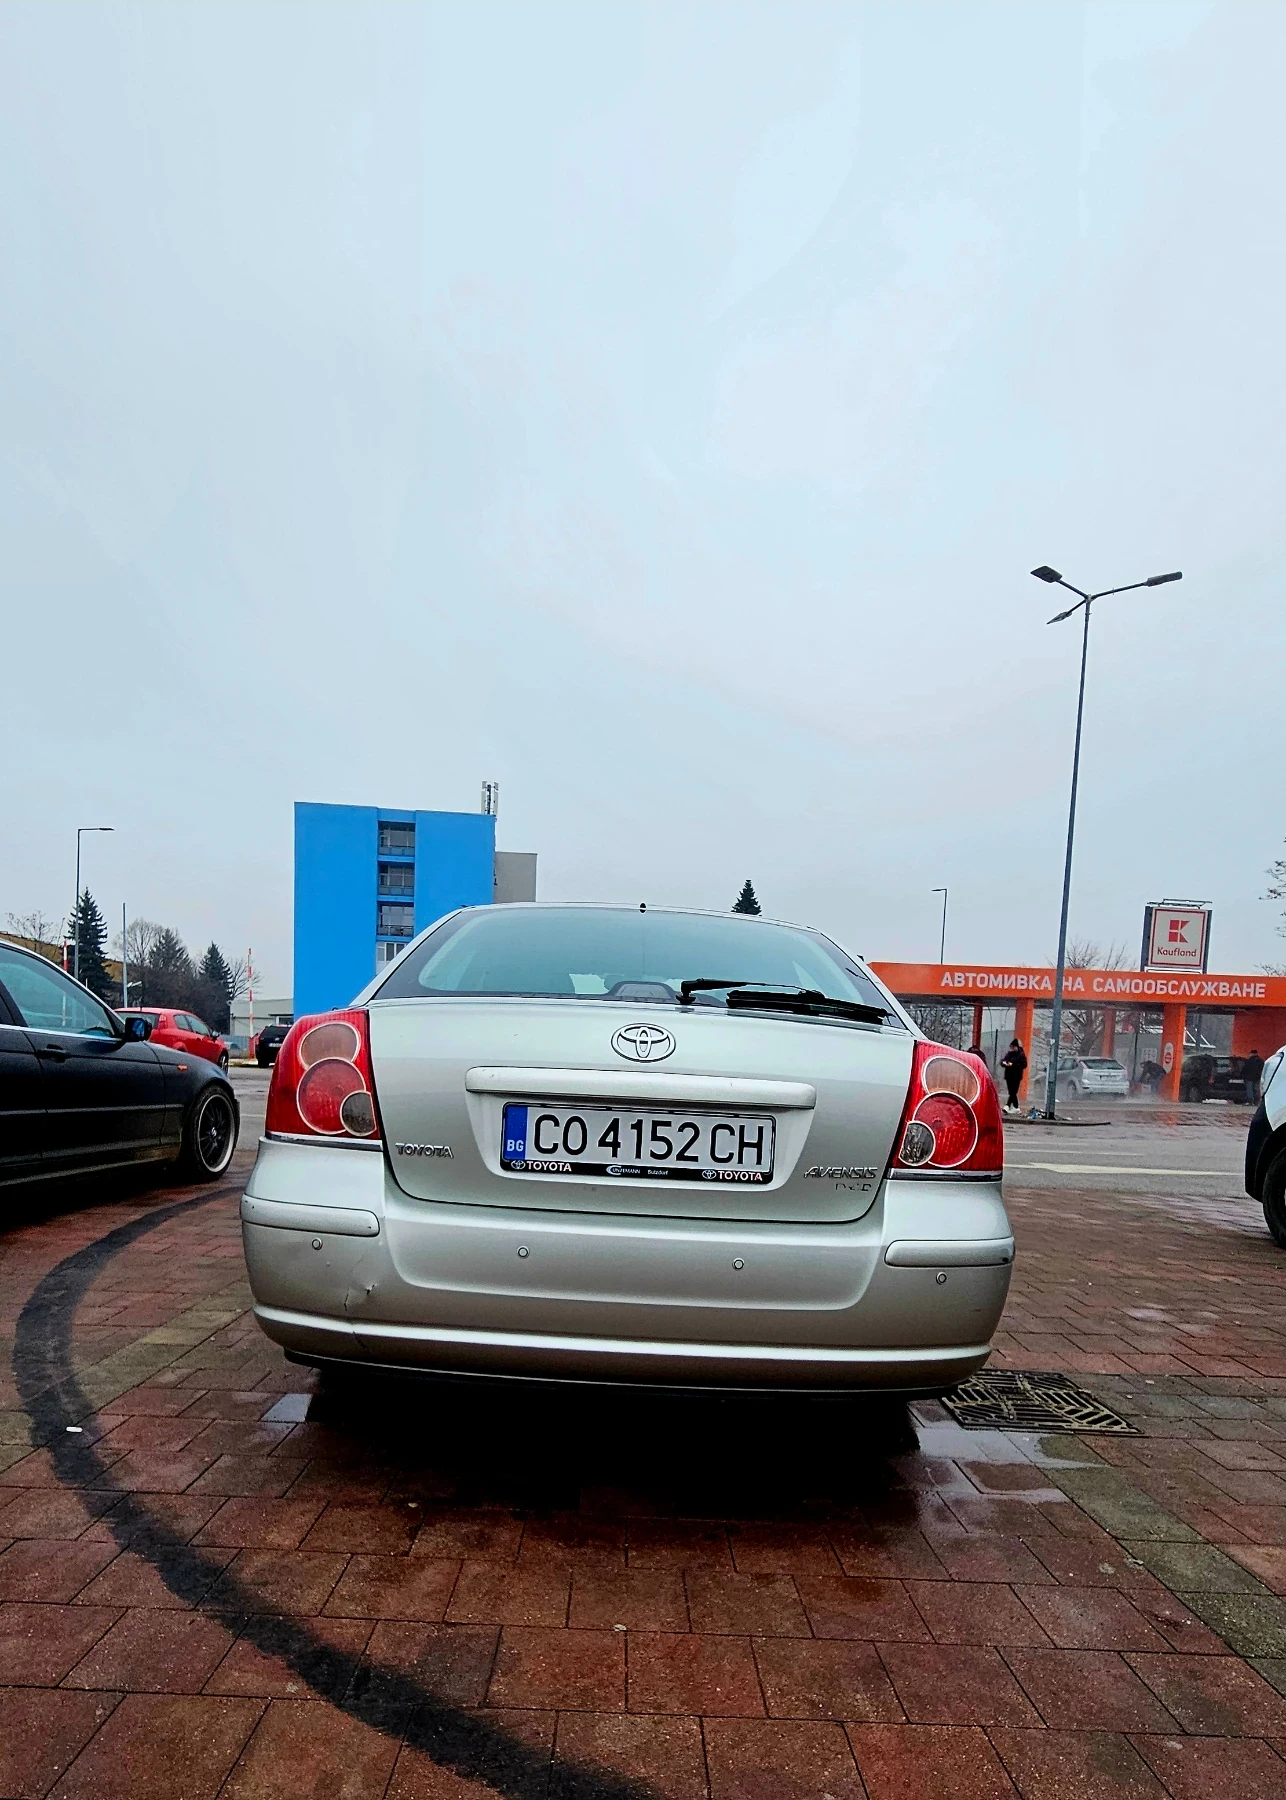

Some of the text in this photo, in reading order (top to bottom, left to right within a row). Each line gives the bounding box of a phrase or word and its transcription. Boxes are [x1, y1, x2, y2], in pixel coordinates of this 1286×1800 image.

[1157, 946, 1197, 957] Kaufland
[940, 971, 1267, 998] АВТОМИВКА НА САМООБСЛУЖВАНЕ
[506, 1140, 524, 1152] BG
[533, 1114, 765, 1166] CO 4152 CH
[395, 1142, 454, 1159] TOYOTA
[526, 1161, 572, 1172] TOYOTA
[804, 1166, 878, 1179] AVENSIS
[717, 1170, 763, 1181] TOYOTA
